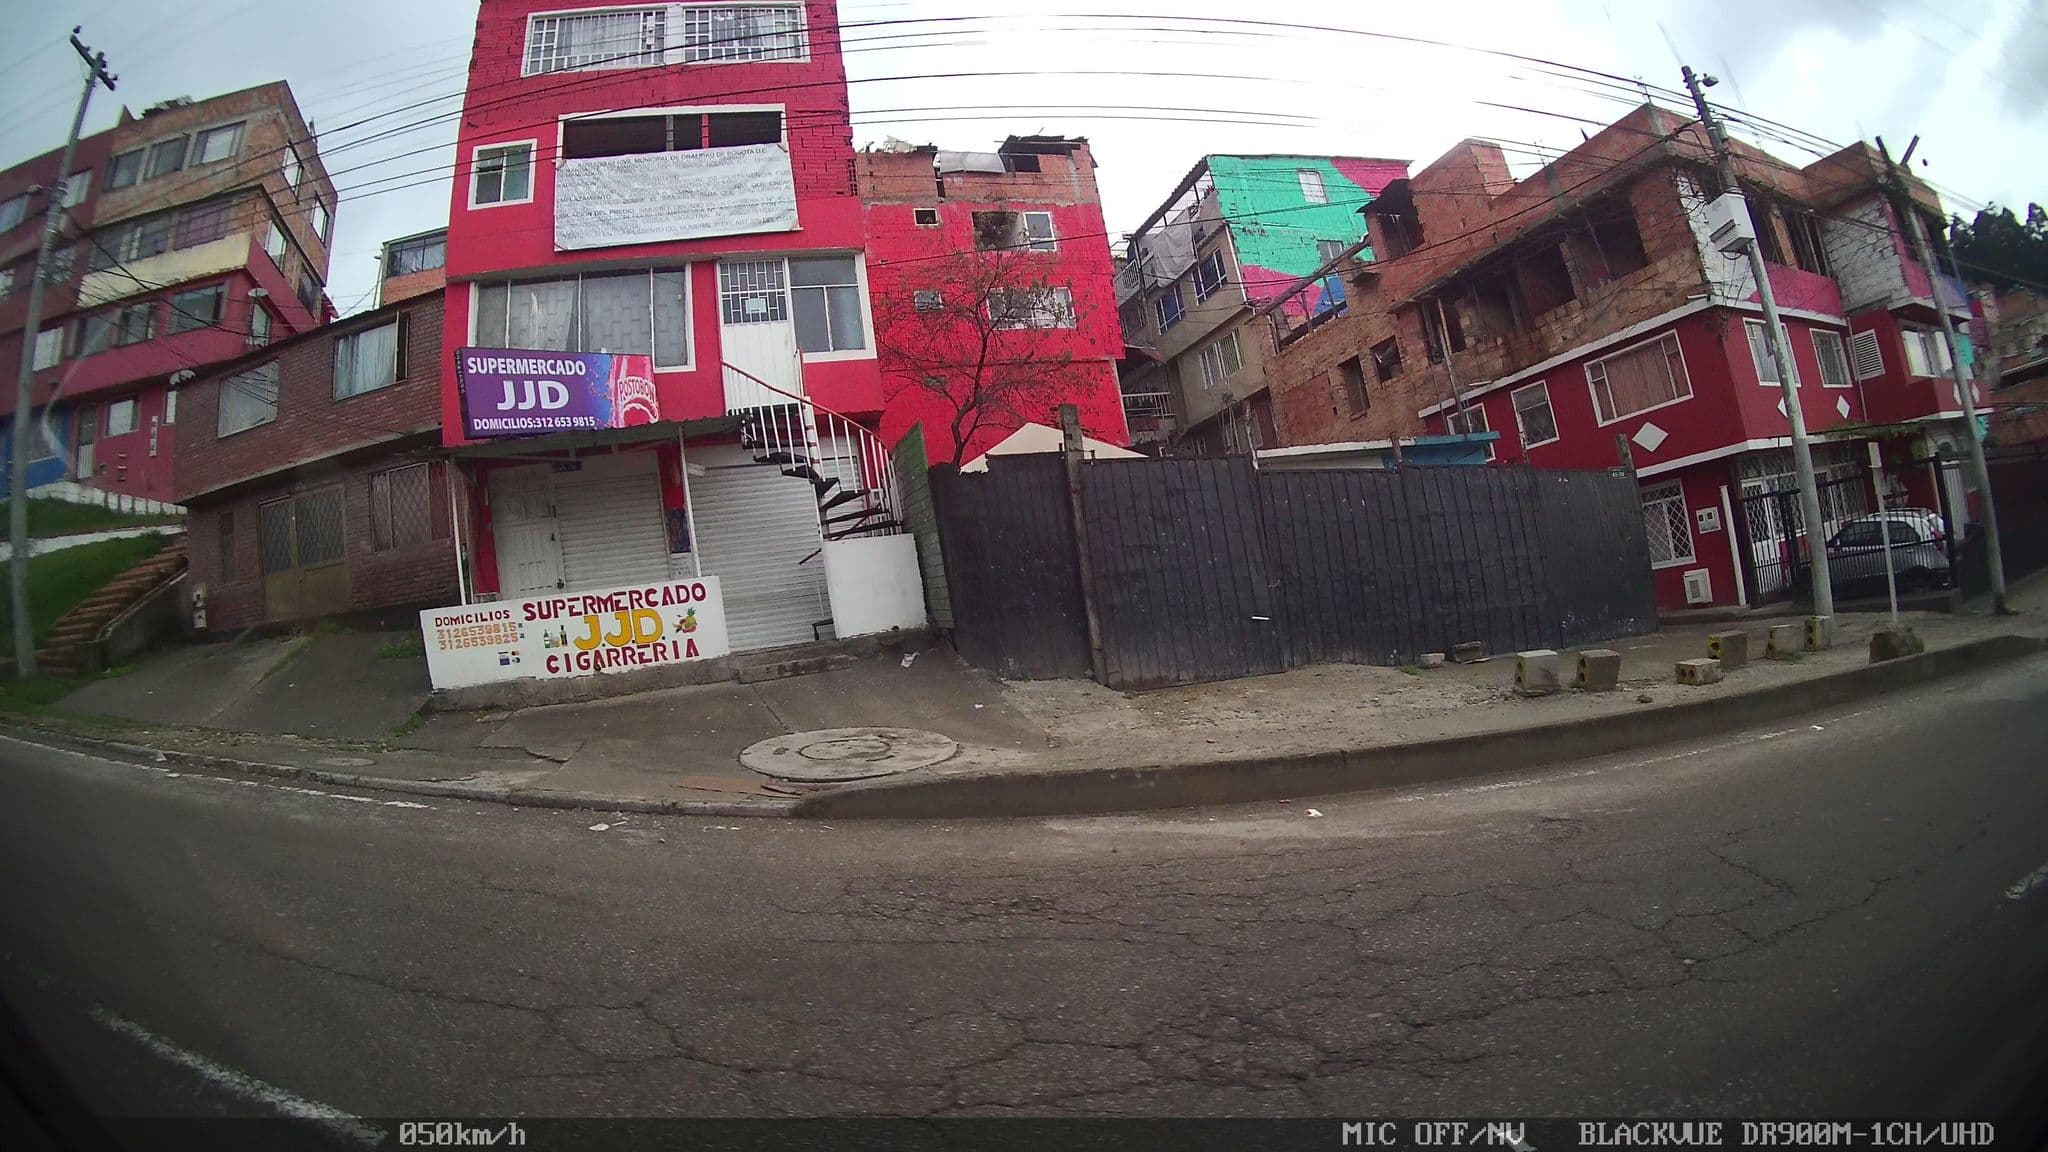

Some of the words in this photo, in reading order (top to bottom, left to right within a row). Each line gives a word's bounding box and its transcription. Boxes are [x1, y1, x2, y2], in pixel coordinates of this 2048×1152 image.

[467, 357, 586, 376] SUPERMERCADO
[497, 380, 570, 410] JJD
[473, 417, 554, 430] DOMICILIOS:312
[554, 416, 572, 427] 653
[573, 416, 596, 427] 9815
[522, 582, 707, 621] SUPERMERCADO
[434, 609, 511, 627] DOMICILIOS
[436, 622, 517, 639] 3126539815
[438, 632, 519, 650] 3126539825
[546, 638, 700, 673] CIGARRERIA
